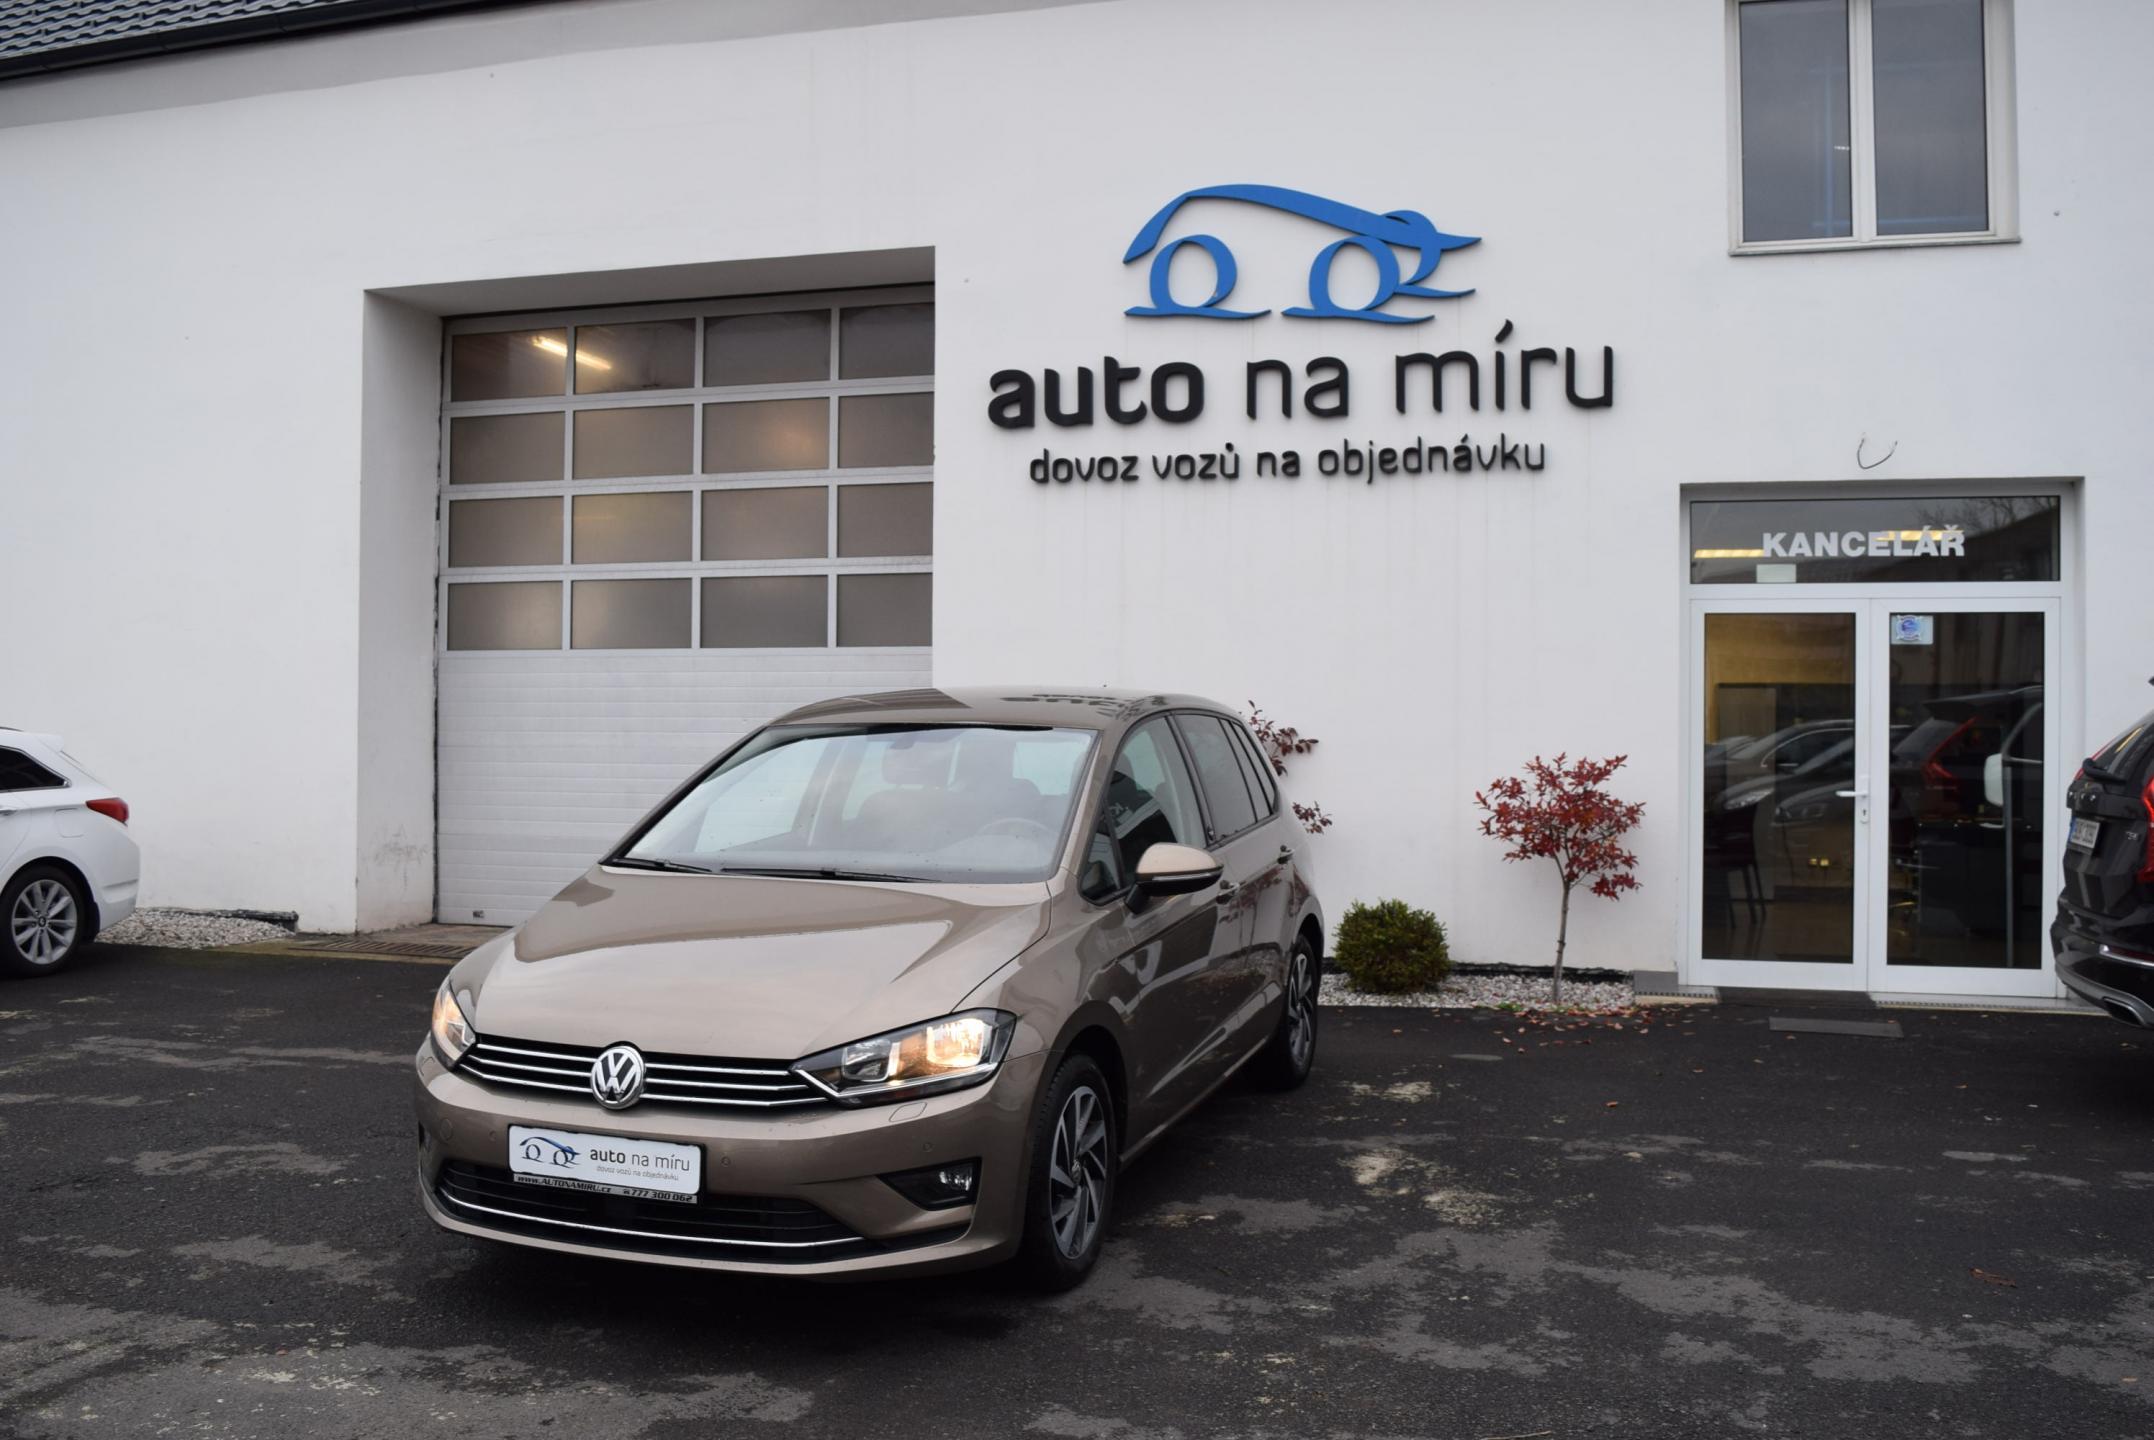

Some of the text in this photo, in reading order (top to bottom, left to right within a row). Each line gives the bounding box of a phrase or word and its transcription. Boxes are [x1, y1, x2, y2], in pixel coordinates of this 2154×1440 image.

[988, 318, 1614, 429] auto na míru
[1029, 432, 1545, 486] dovoz vozů na objednávku
[1762, 524, 1966, 558] KANCELÁŘ
[589, 1148, 690, 1171] auto na míru
[631, 1188, 649, 1198] 777
[651, 1190, 671, 1200] 300
